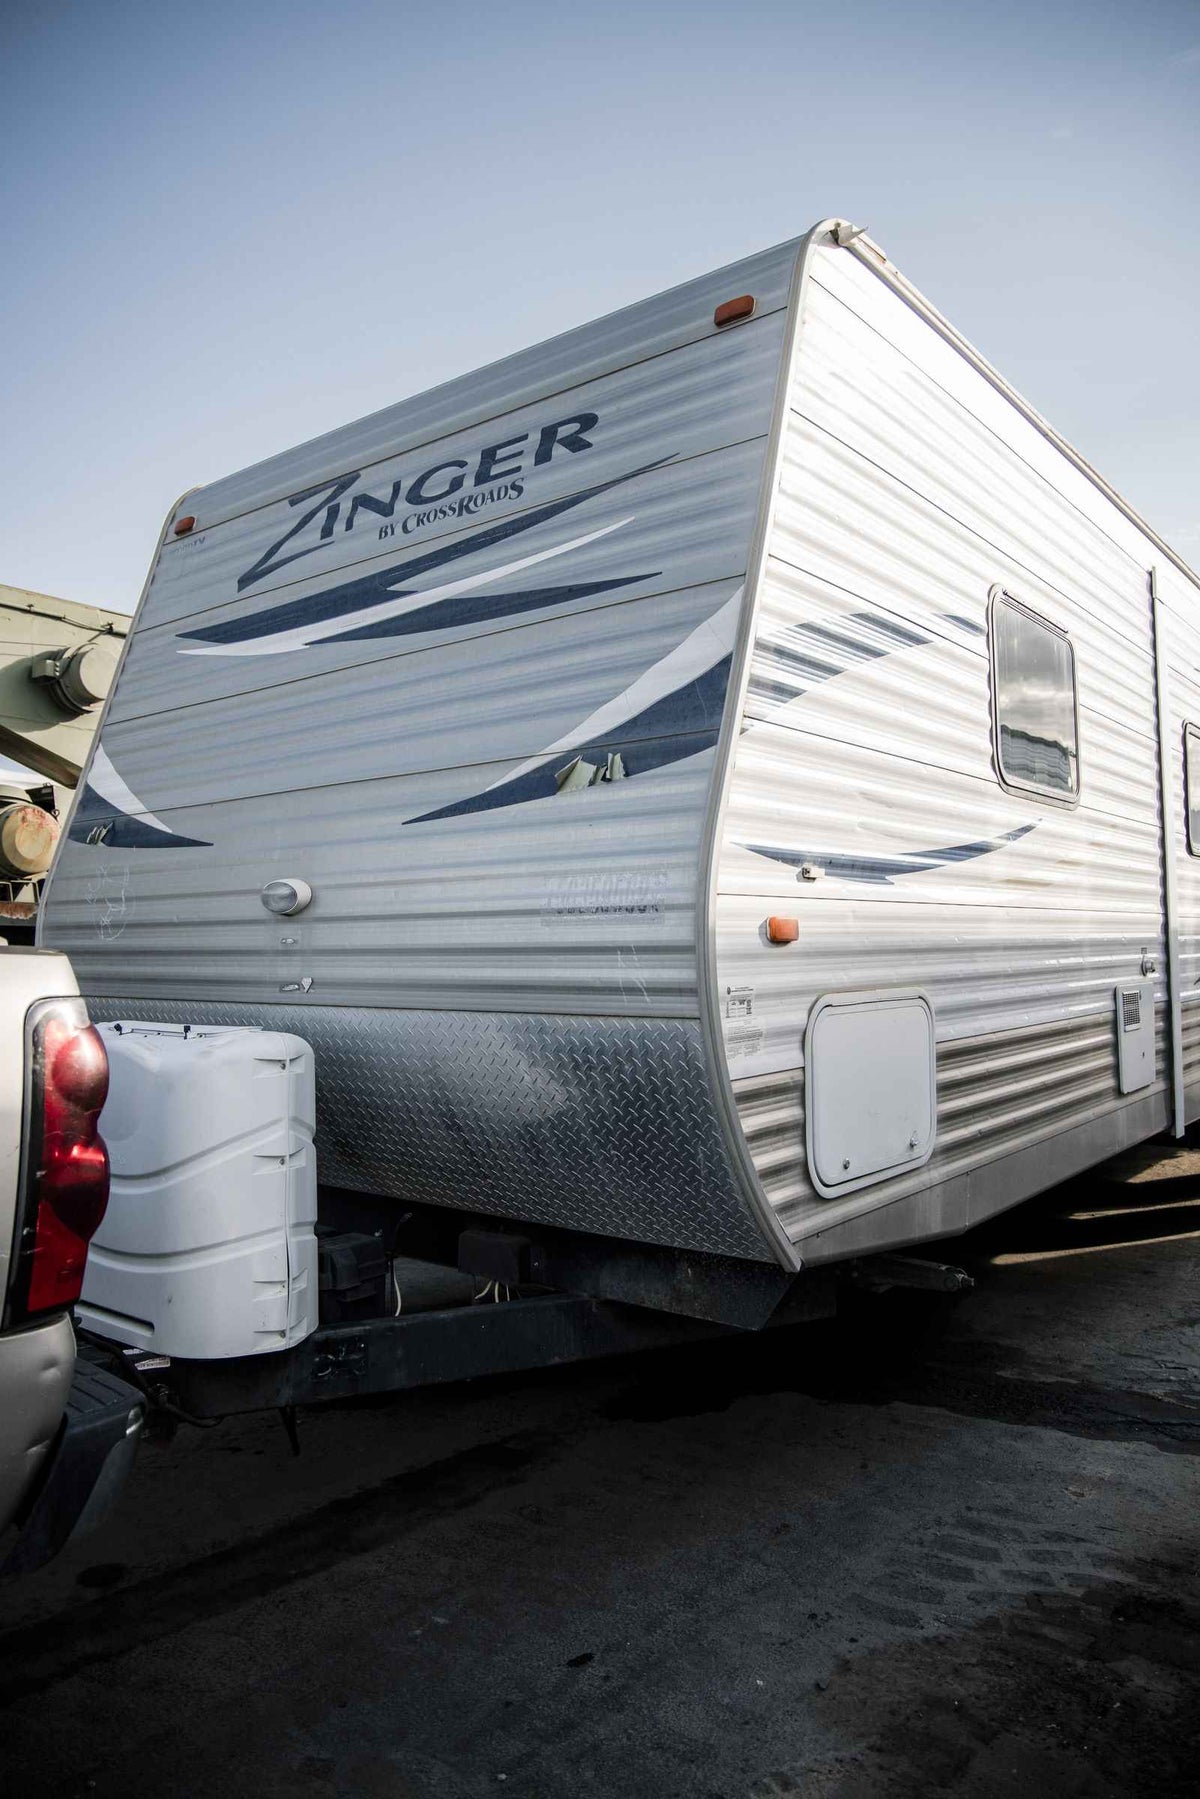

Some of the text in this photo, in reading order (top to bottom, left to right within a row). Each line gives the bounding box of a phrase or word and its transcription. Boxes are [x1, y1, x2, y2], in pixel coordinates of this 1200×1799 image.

[237, 412, 599, 593] ZINGER
[378, 477, 525, 540] BY CROSSROADS
